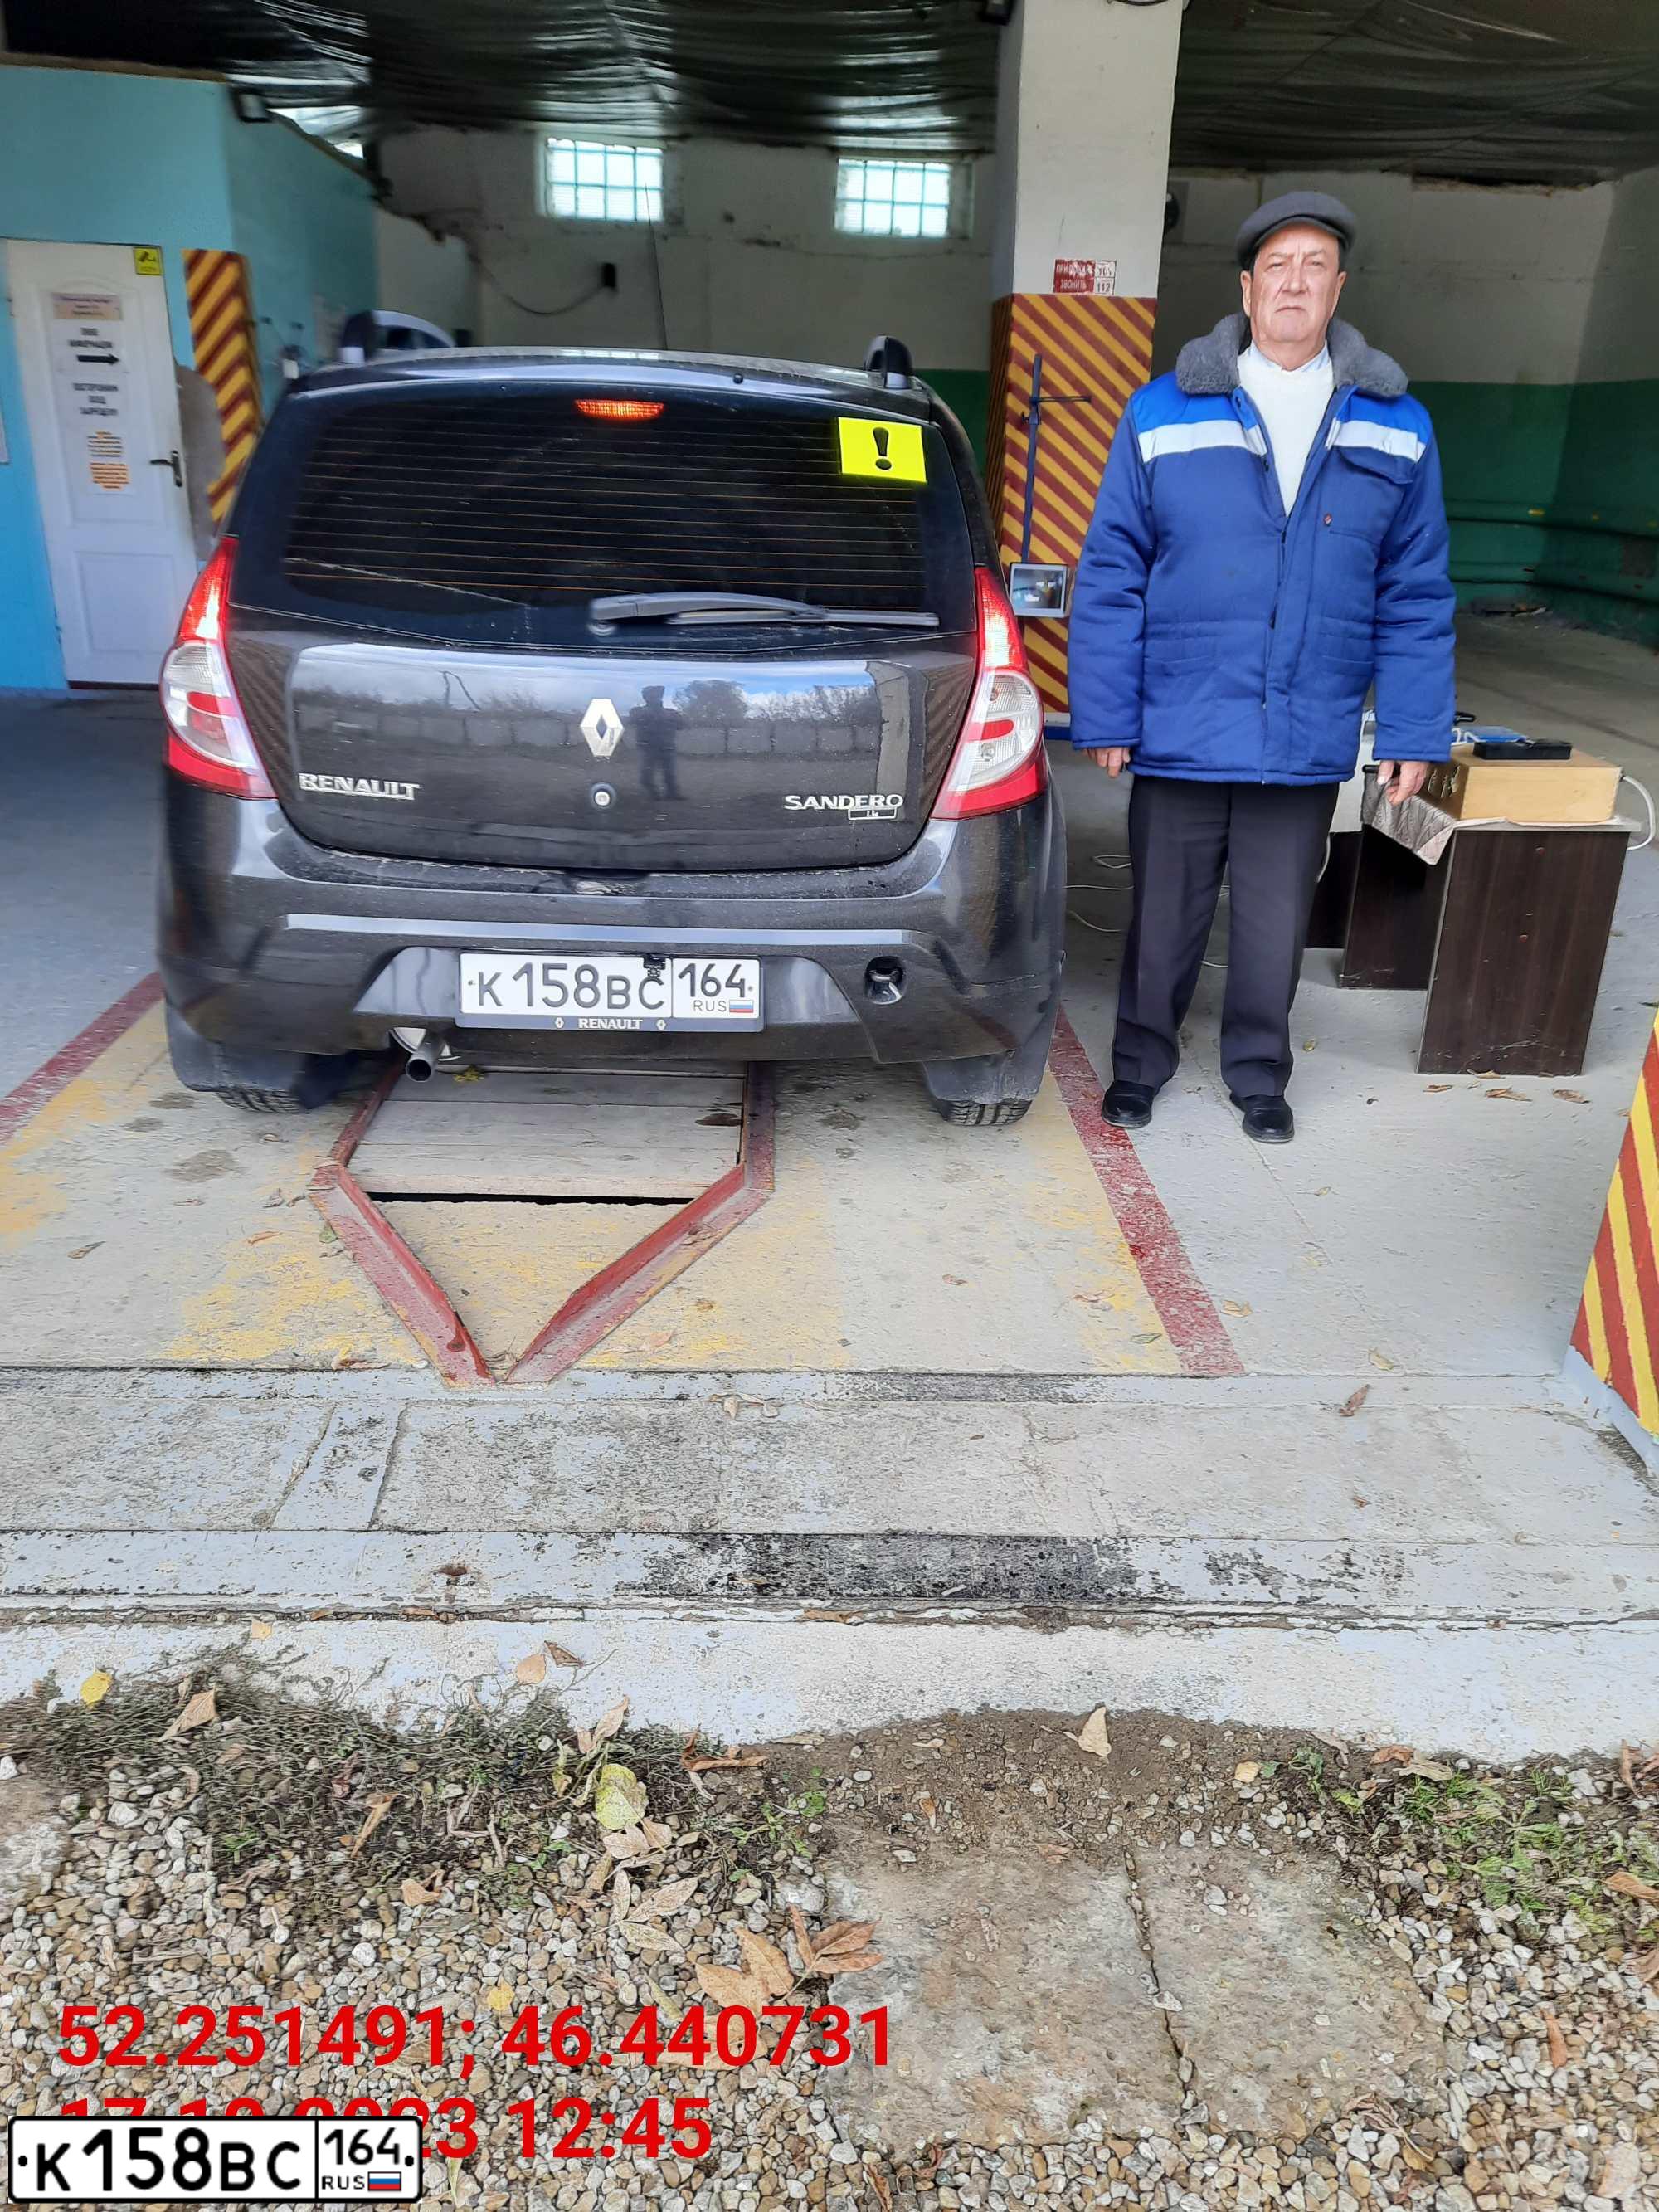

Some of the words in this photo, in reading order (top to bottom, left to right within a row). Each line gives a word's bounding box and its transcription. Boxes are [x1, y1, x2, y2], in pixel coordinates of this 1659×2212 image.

[1097, 282, 1111, 293] 112
[298, 772, 420, 801] RENAULT
[784, 794, 904, 811] SANDERO
[478, 962, 664, 1010] К158ВС
[678, 962, 746, 998] 164
[693, 1000, 727, 1012] RUS
[578, 1017, 644, 1030] RENAULT
